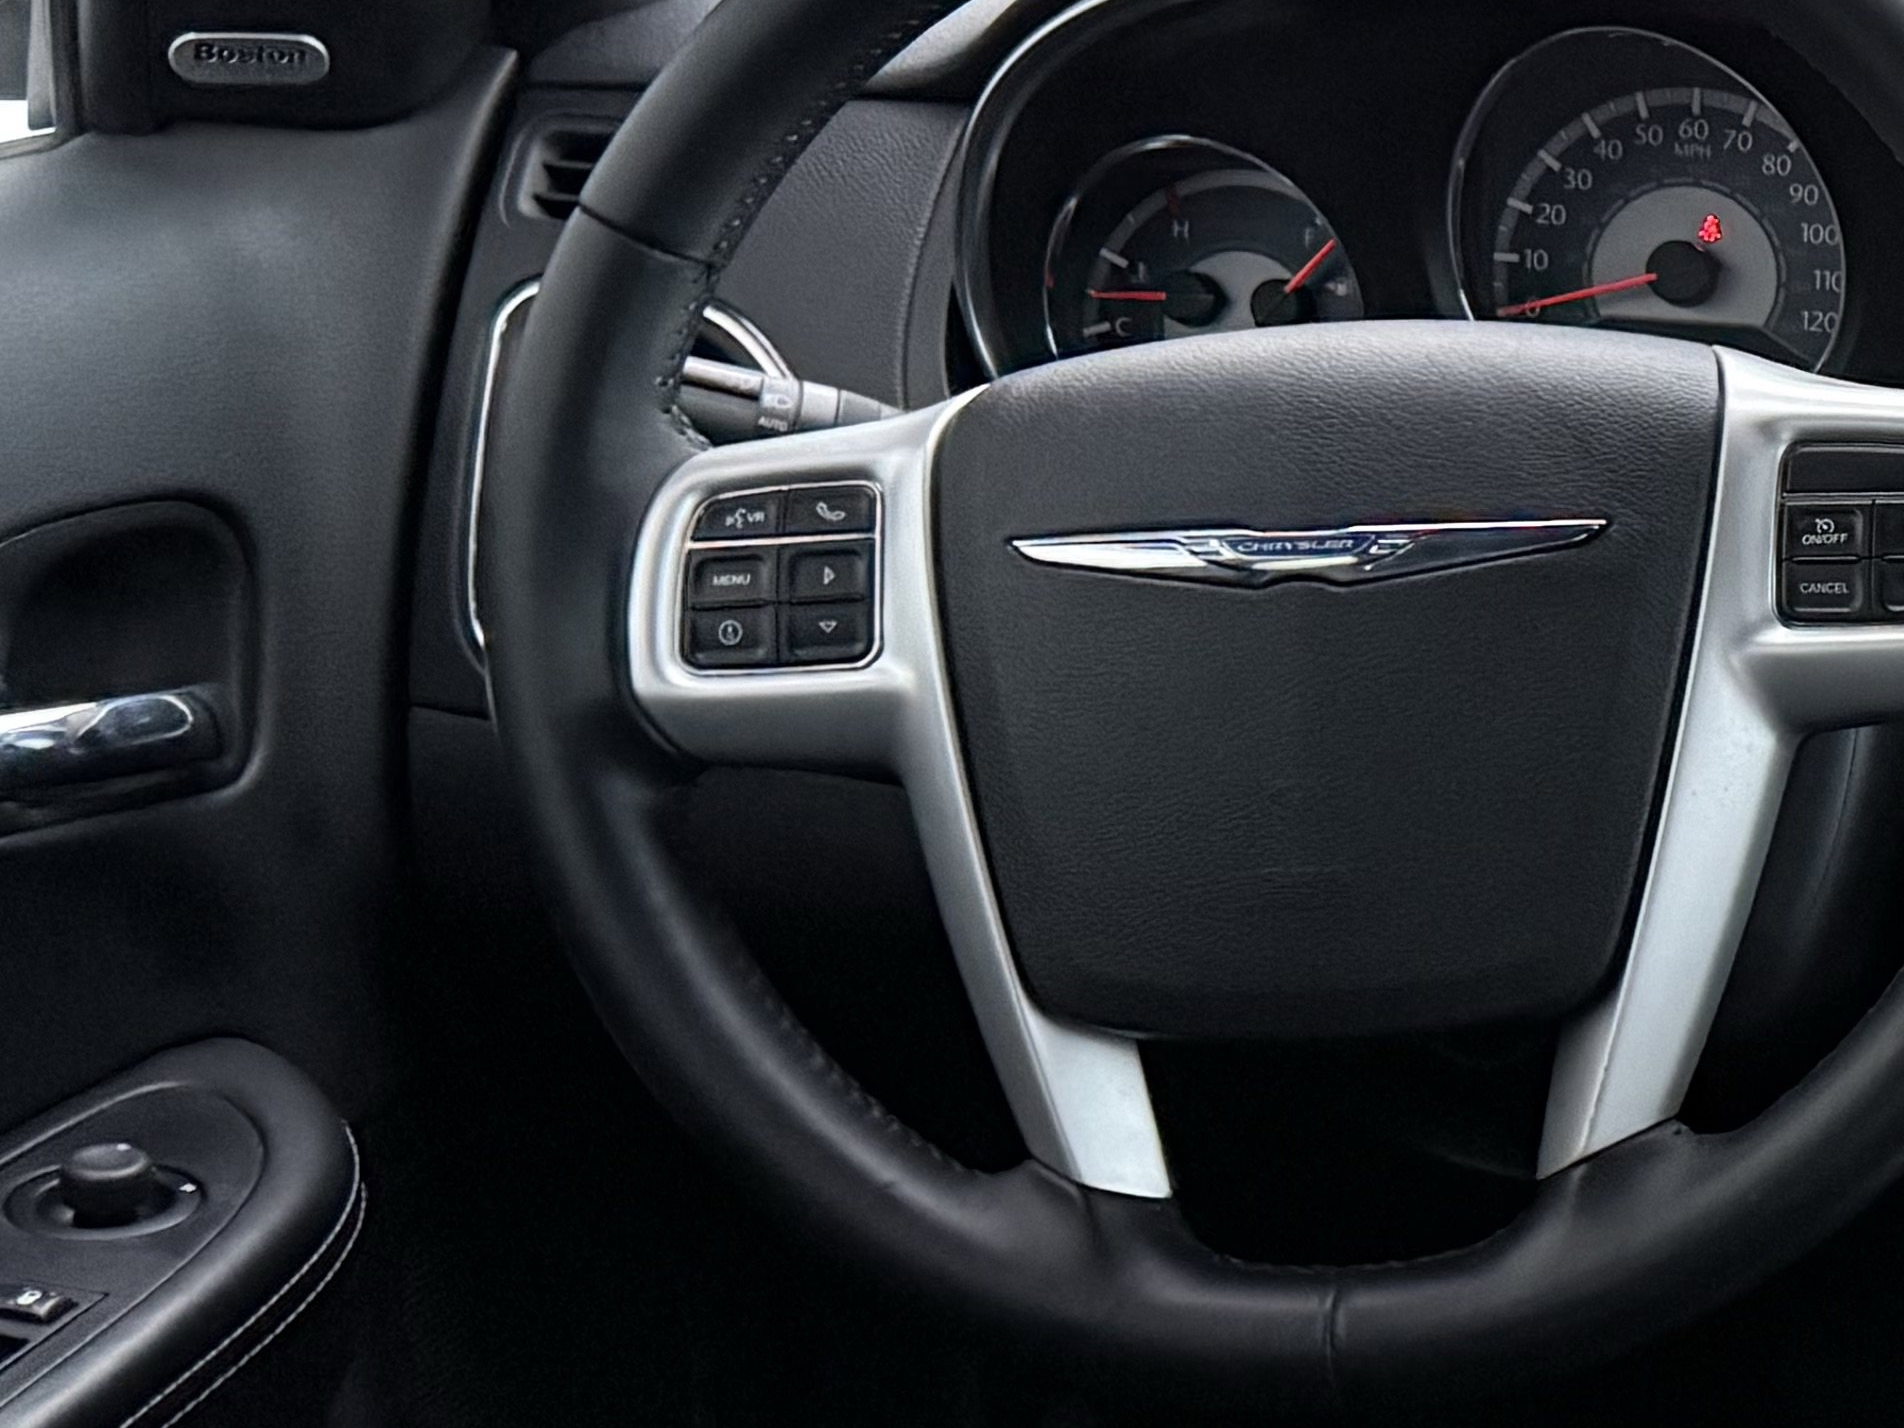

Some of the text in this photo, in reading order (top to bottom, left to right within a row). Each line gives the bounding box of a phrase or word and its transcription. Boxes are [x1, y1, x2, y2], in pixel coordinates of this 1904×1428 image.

[194, 43, 306, 63] Boston
[1634, 125, 1663, 146] 50
[1678, 119, 1709, 140] 60
[1594, 139, 1623, 161] 40
[1722, 130, 1753, 152] 70
[1674, 144, 1711, 159] MPH
[1762, 154, 1791, 175] 80
[1563, 169, 1593, 190] 30
[1789, 184, 1819, 204] 90
[1535, 204, 1566, 225] 20
[1800, 223, 1840, 245] 100
[1523, 250, 1549, 270] 10
[1802, 311, 1839, 333] 120
[758, 417, 789, 432] AUTO
[1238, 540, 1353, 551] CHRYSLER
[1802, 533, 1848, 545] ON/OFF
[713, 575, 751, 586] MENU
[1800, 584, 1849, 594] CANCEL
